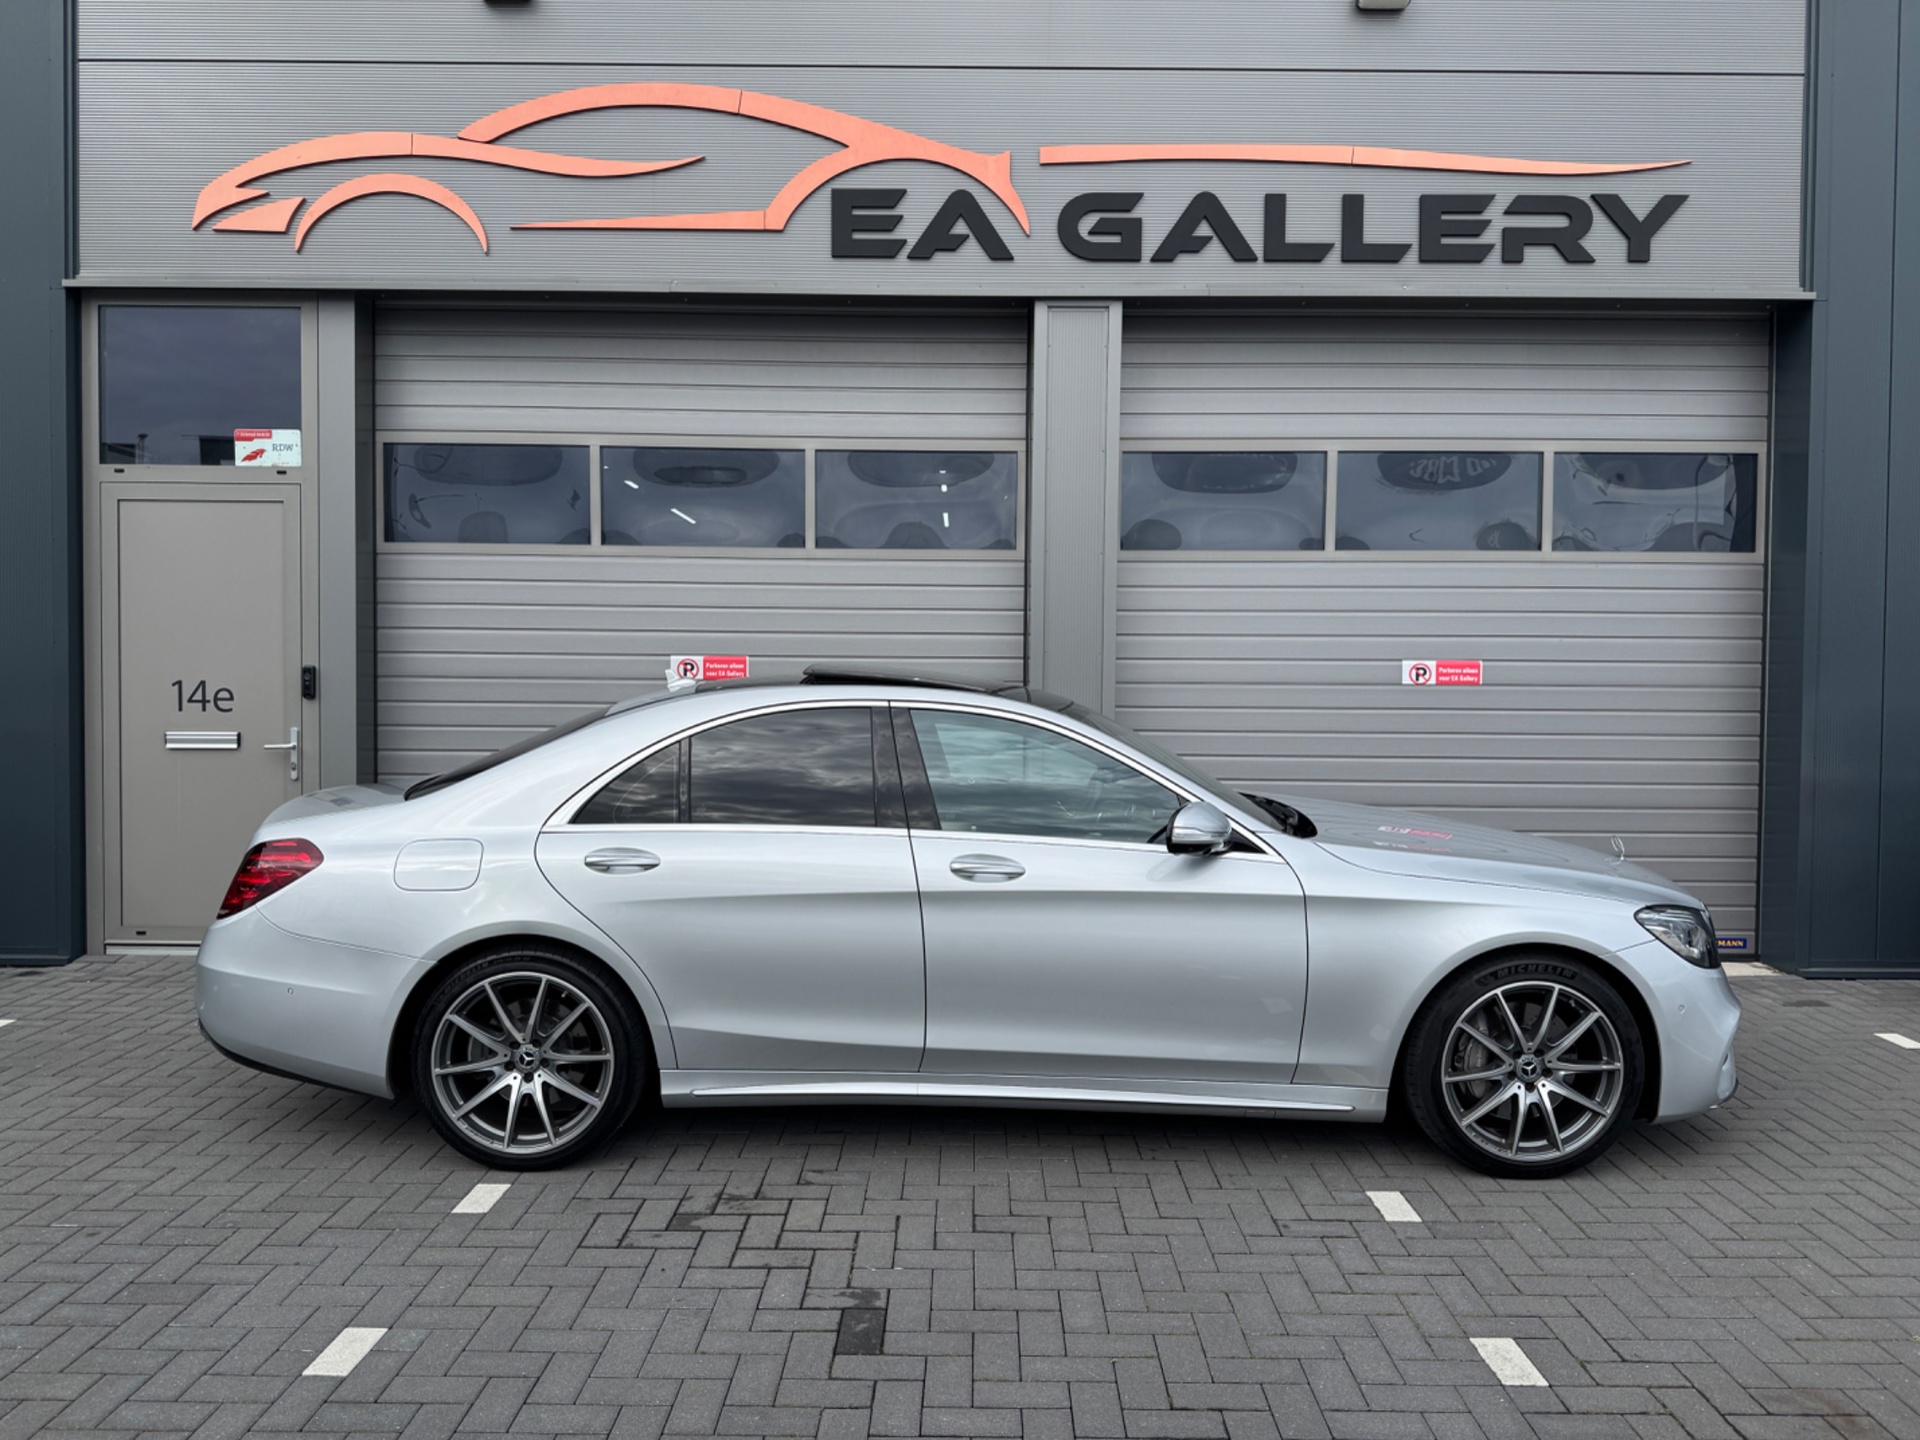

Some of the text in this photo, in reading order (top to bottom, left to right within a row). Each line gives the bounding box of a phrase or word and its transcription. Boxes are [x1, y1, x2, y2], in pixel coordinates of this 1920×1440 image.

[831, 188, 1690, 265] EA GALLERY
[272, 443, 293, 452] RDW
[171, 680, 234, 713] 14e
[1497, 964, 1573, 978] MICHELIN
